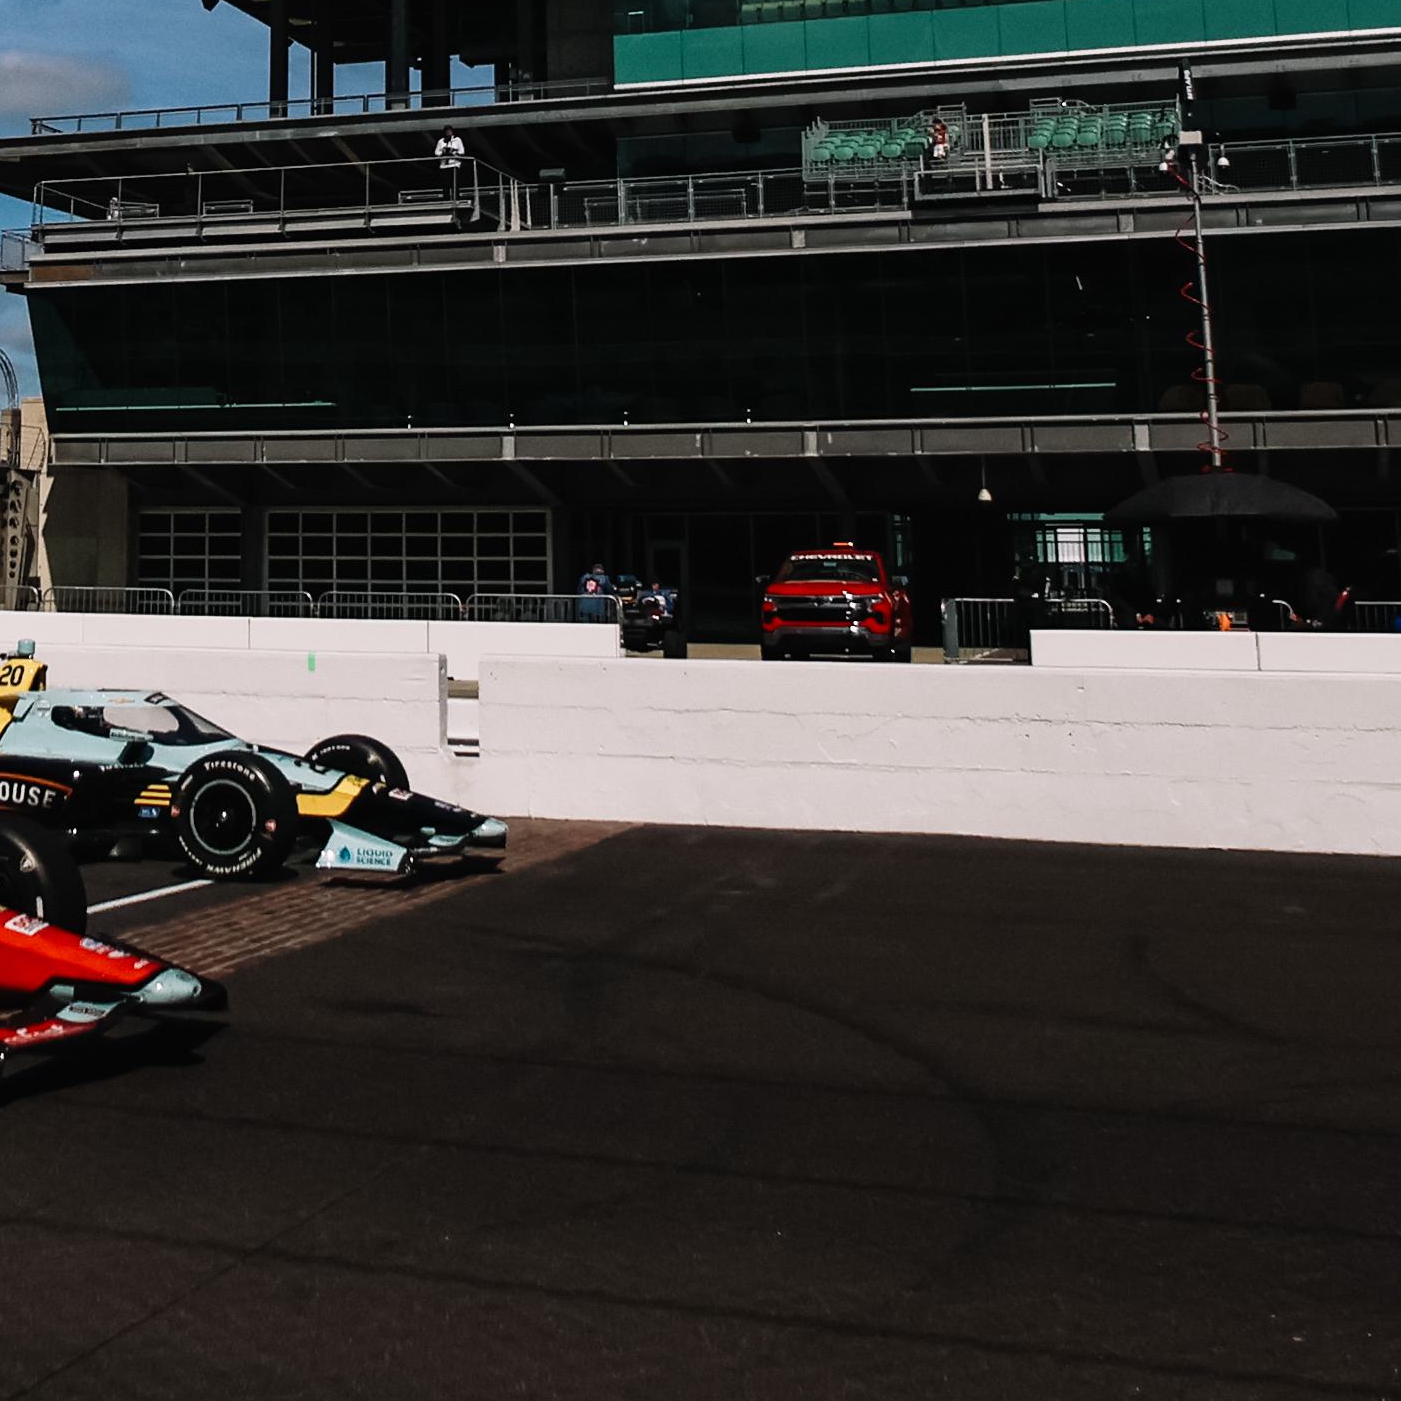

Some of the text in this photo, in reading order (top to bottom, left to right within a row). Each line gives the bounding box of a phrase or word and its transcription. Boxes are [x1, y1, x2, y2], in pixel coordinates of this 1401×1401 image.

[204, 760, 256, 781] Firestone
[356, 848, 394, 857] LIQUID
[356, 858, 392, 867] SCIENCE
